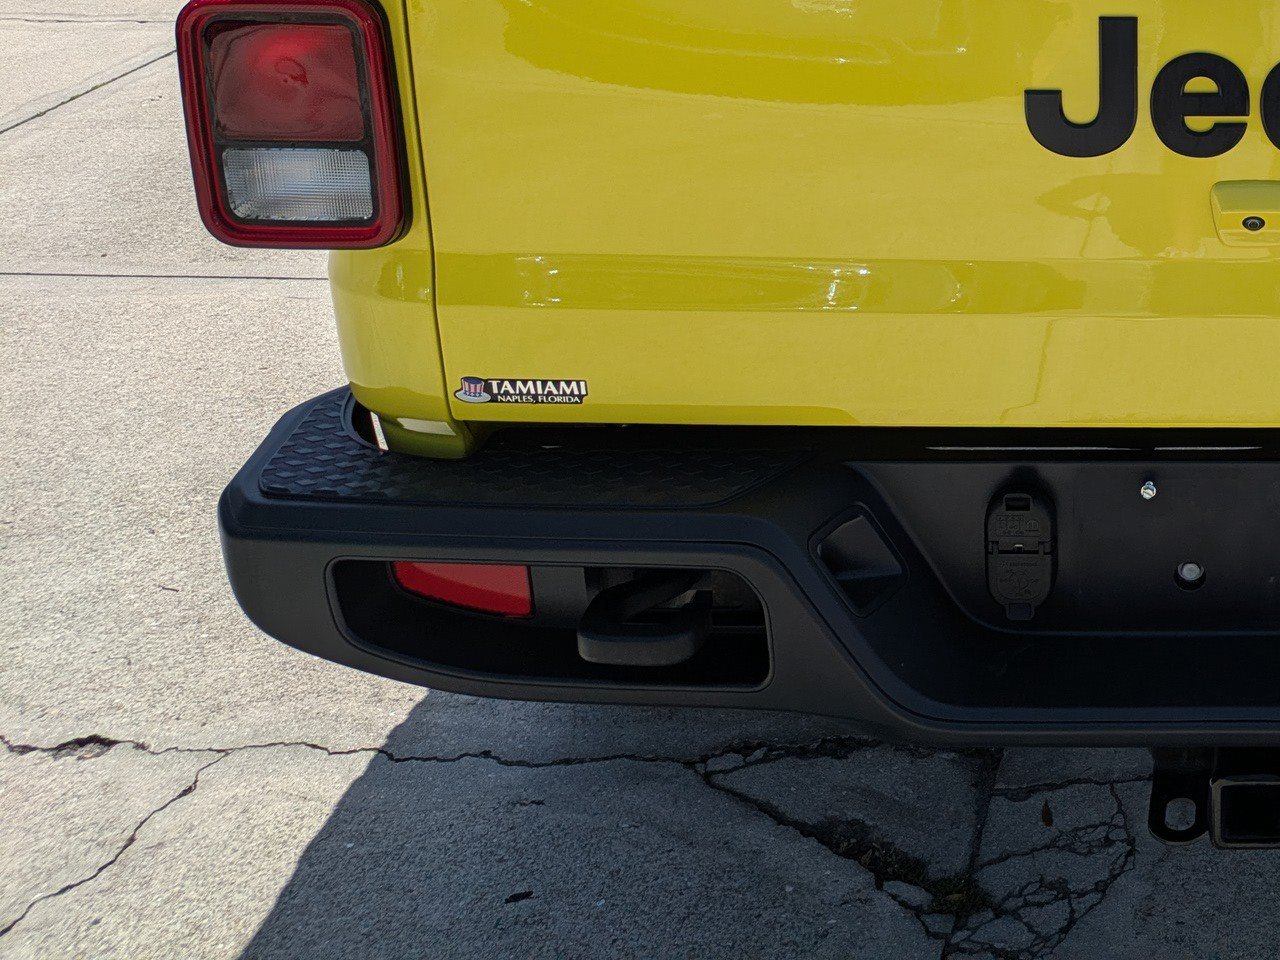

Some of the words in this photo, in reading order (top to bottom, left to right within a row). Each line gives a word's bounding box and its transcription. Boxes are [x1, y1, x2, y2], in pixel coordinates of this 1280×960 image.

[488, 380, 587, 395] TAMIAMI
[497, 395, 536, 403] NAPLES,
[538, 395, 581, 403] FLORIDA
